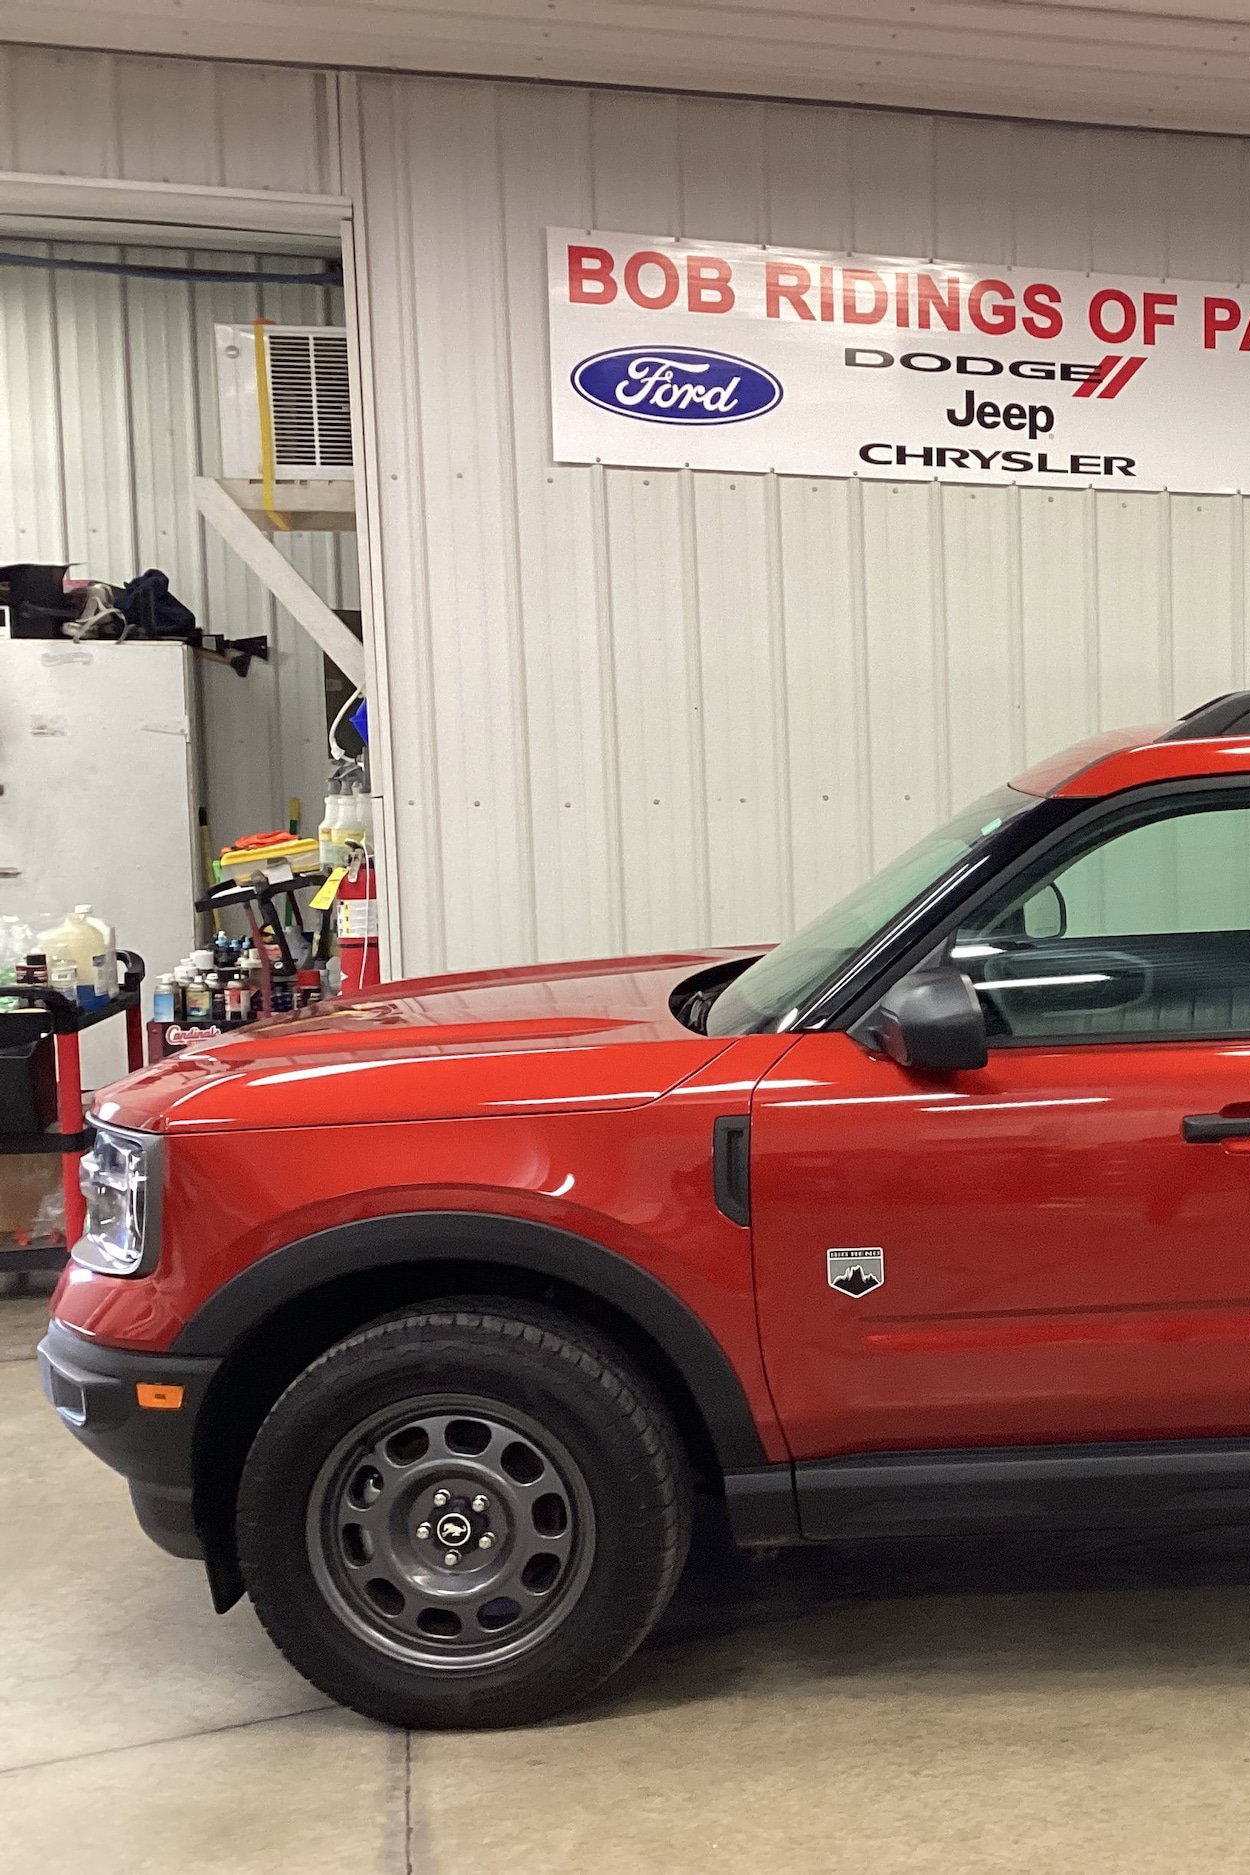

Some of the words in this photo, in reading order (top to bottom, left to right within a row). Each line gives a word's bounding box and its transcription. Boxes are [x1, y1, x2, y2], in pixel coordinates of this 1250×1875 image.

[567, 245, 735, 315] BOB
[765, 262, 1063, 340] RIDINGS
[1087, 287, 1178, 345] OF
[614, 356, 741, 413] Ford
[844, 347, 1104, 383] DODGE
[946, 389, 1055, 440] Jeep
[858, 442, 1137, 477] CHRYSLER
